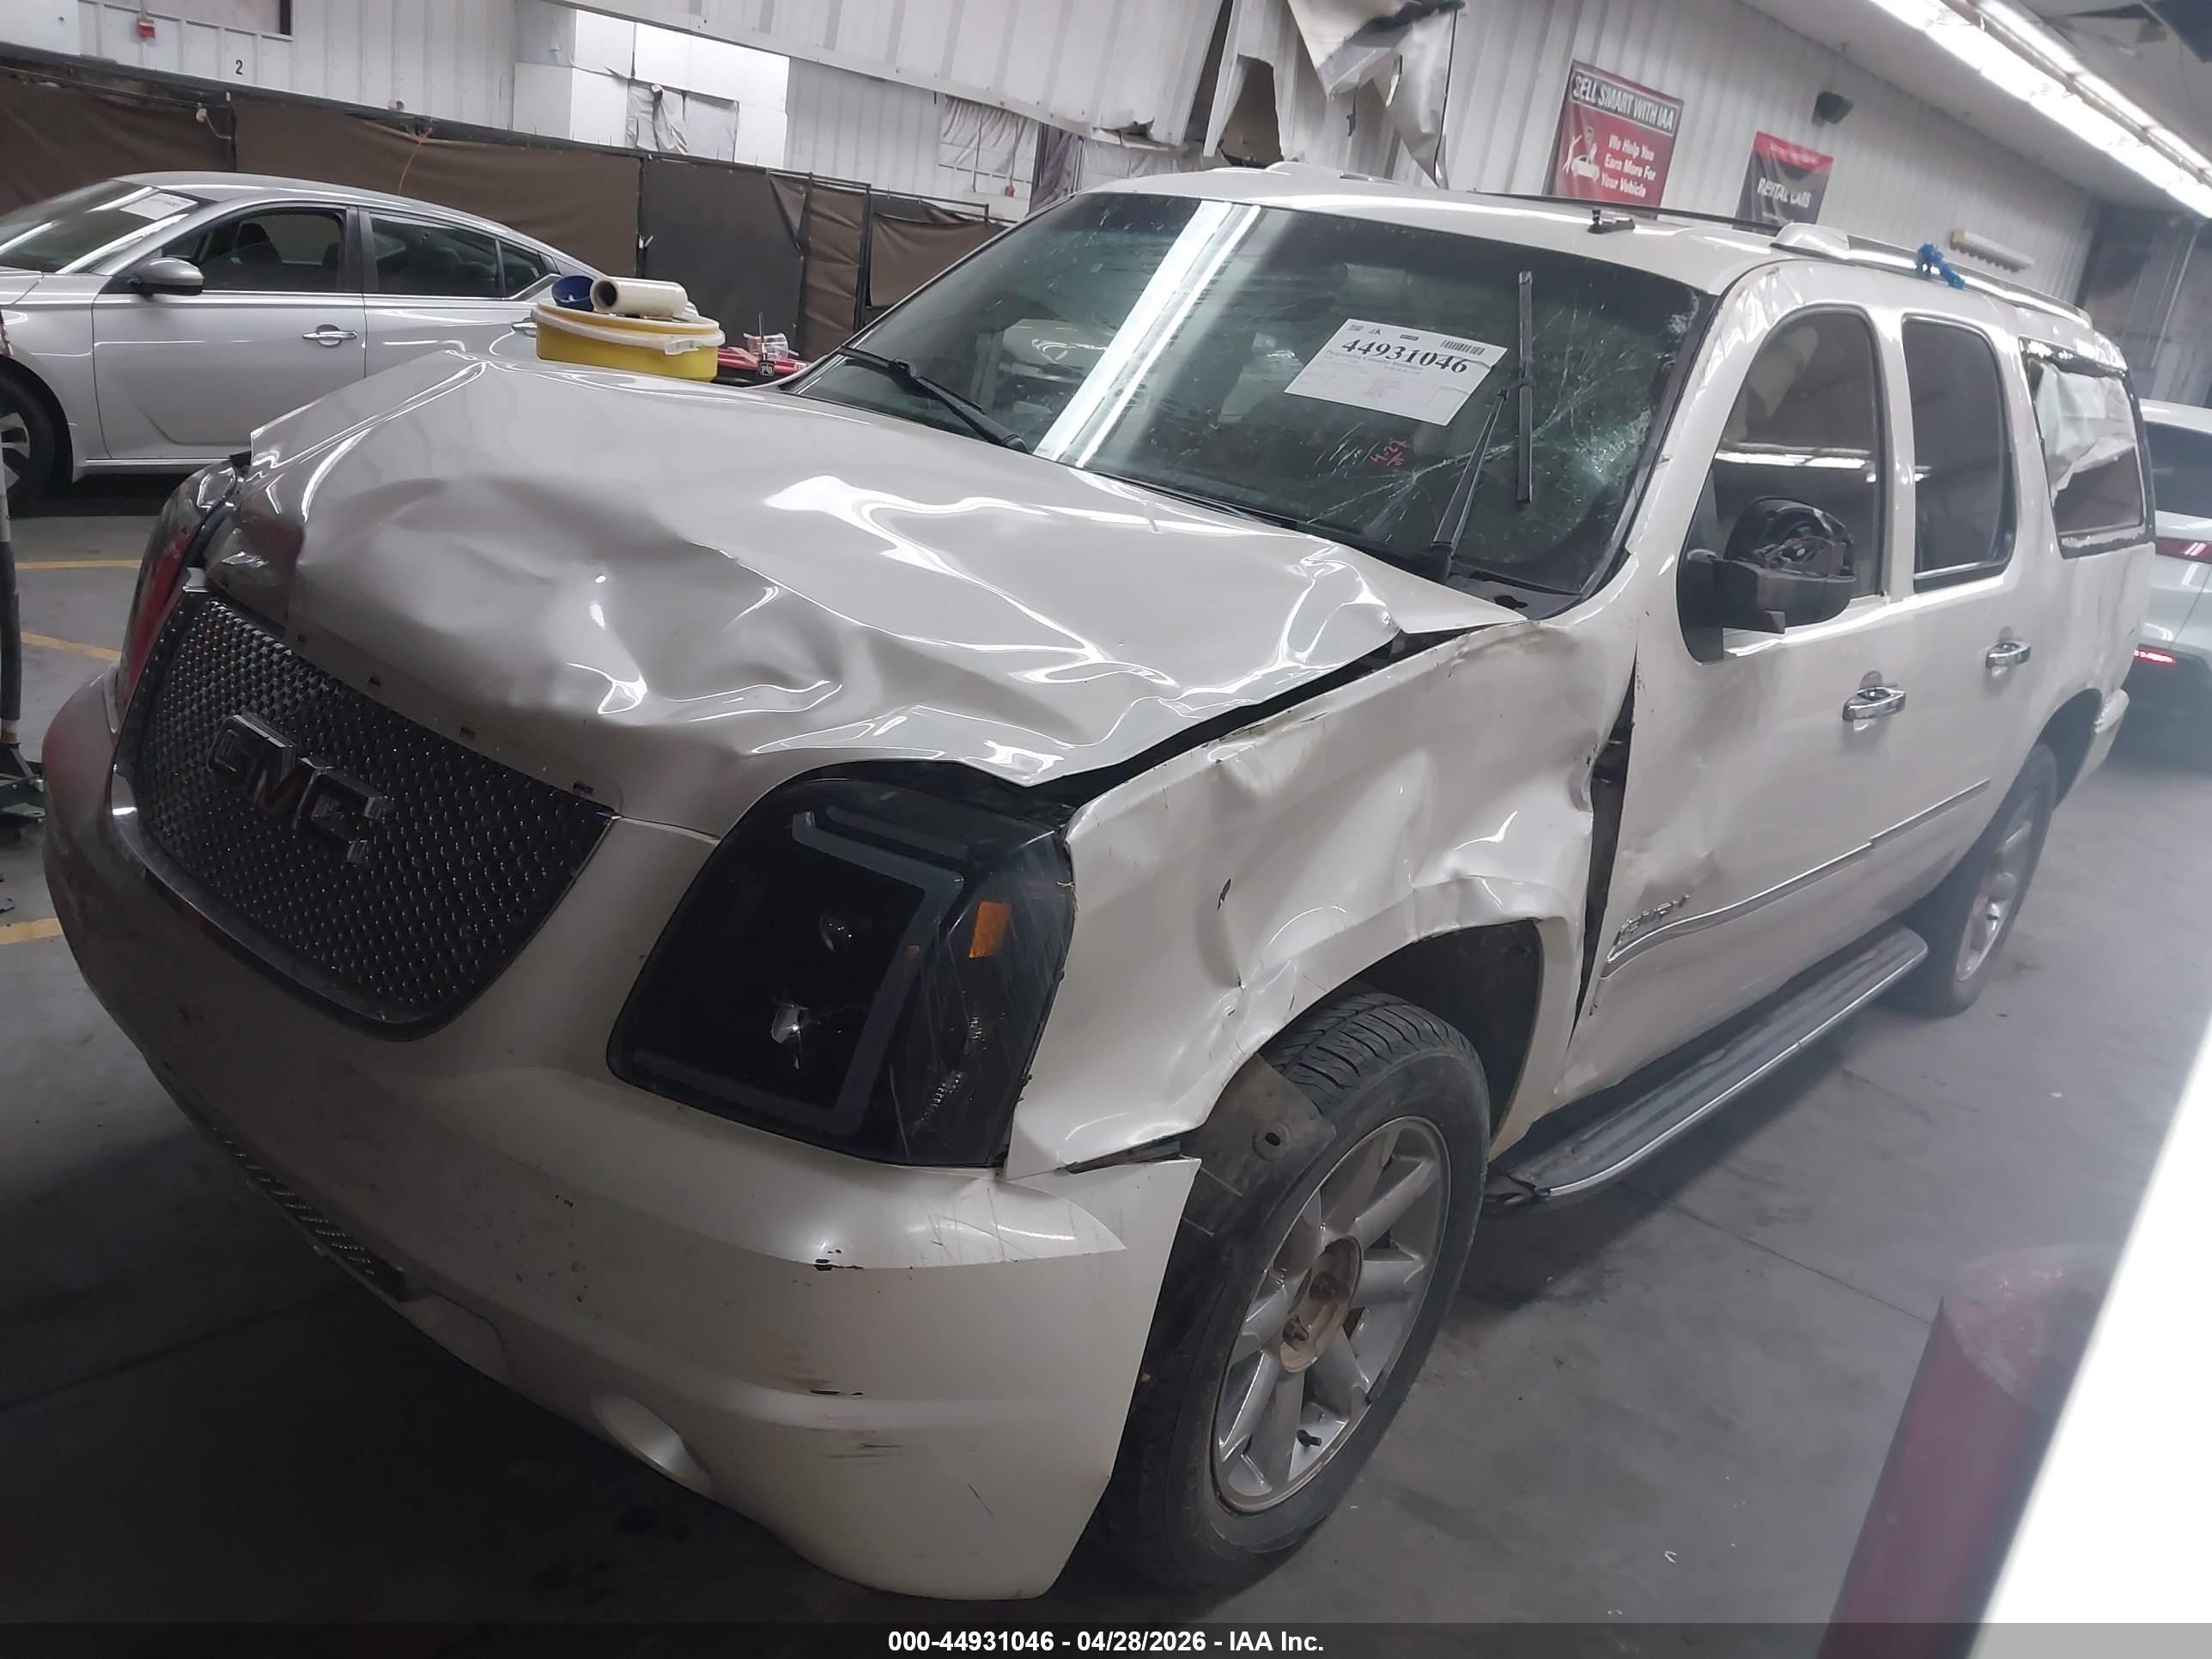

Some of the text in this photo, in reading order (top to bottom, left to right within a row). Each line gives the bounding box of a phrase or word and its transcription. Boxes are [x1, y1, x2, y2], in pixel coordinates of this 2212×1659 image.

[235, 59, 243, 76] 2
[1572, 76, 1597, 103] SELL
[1598, 84, 1634, 115] SMART
[1633, 96, 1658, 125] WITH
[1621, 137, 1640, 159] Help
[1641, 143, 1655, 161] You
[1604, 153, 1656, 181] Earn More For
[1601, 172, 1647, 198] Your Vehicle
[1342, 339, 1468, 374] 44931046
